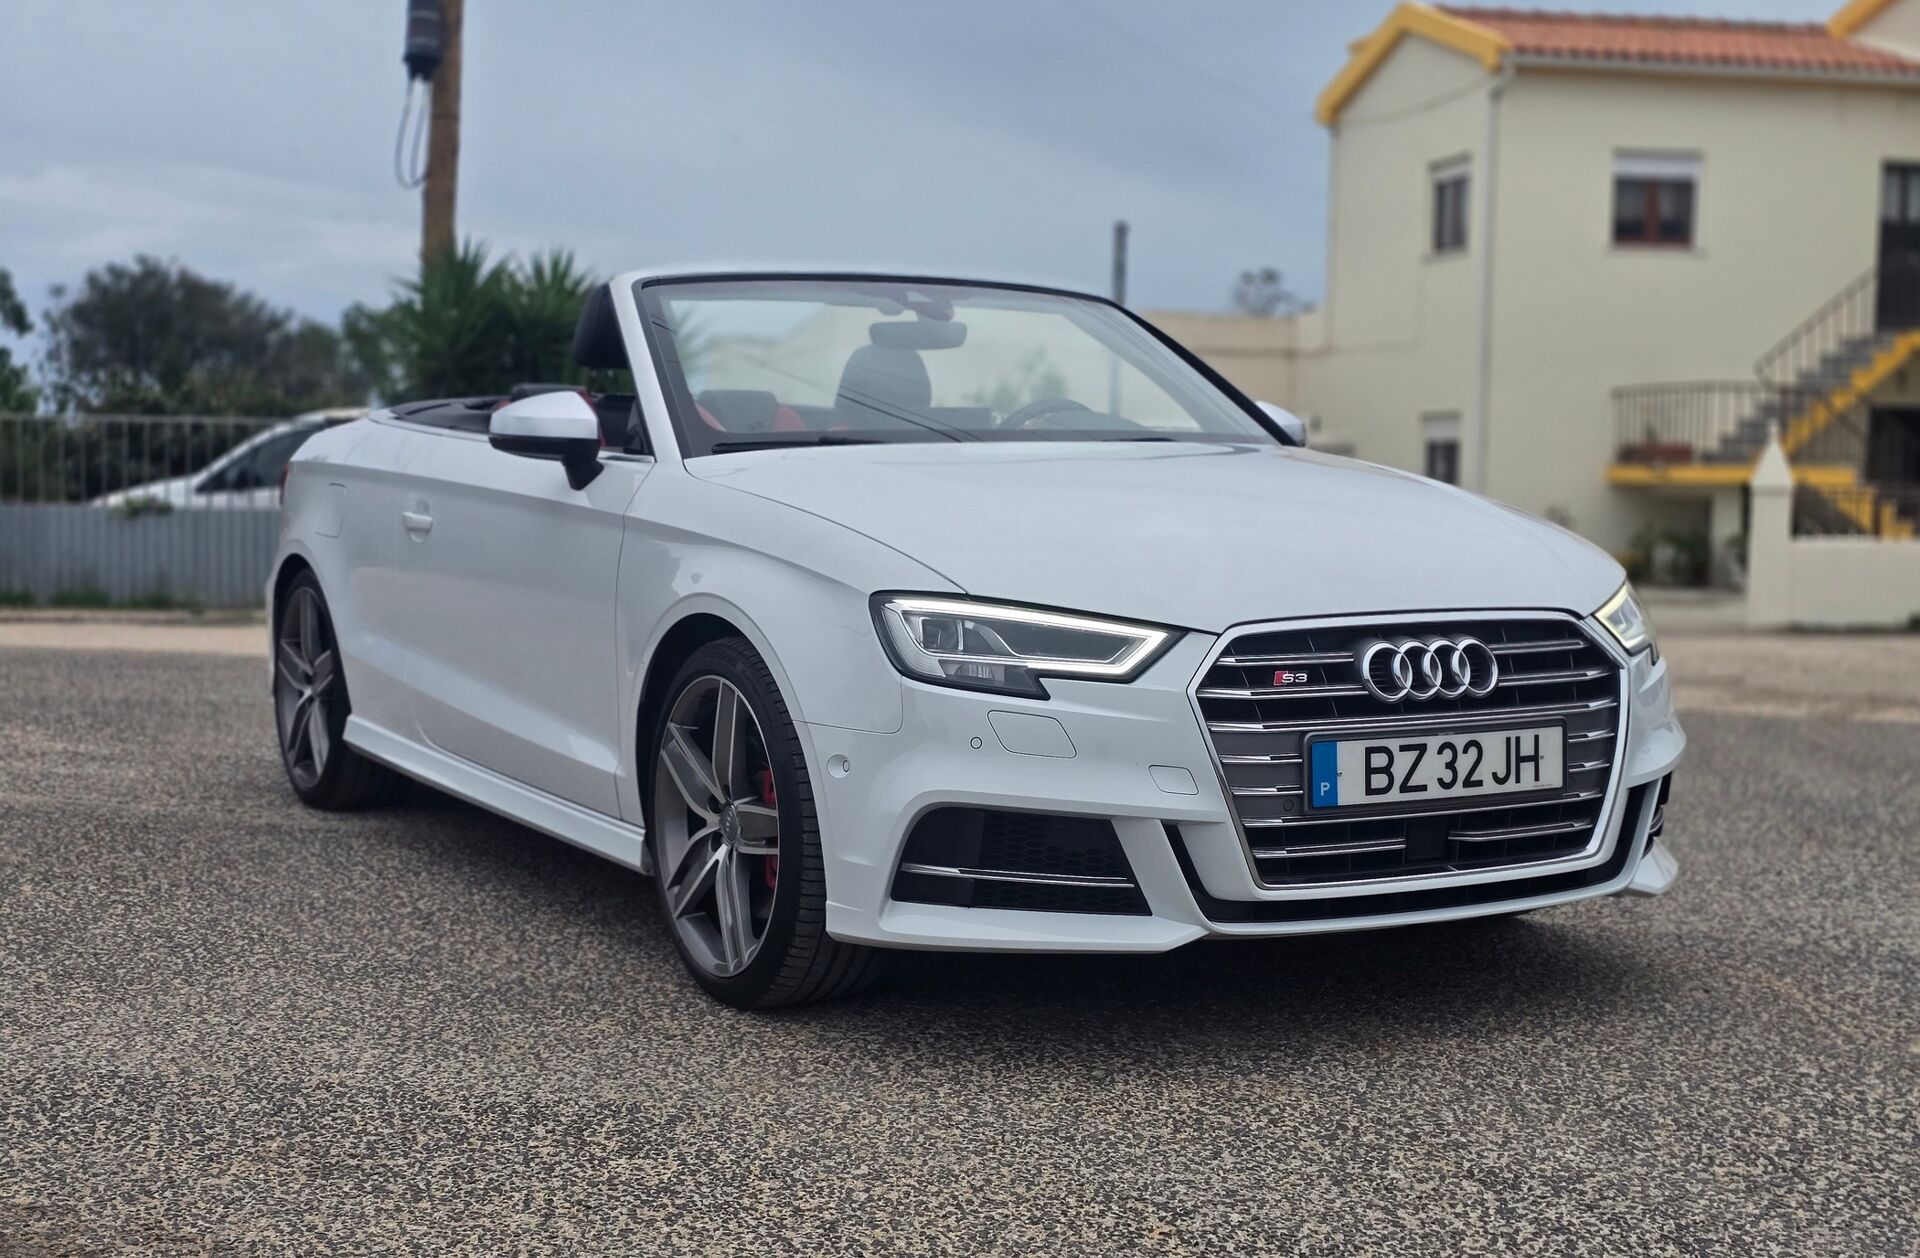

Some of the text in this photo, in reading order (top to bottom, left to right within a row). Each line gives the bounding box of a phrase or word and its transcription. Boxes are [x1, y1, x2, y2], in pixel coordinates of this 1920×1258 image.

[1281, 673, 1308, 683] S3
[1364, 734, 1540, 796] BZ 32 JH
[1320, 781, 1330, 796] P
